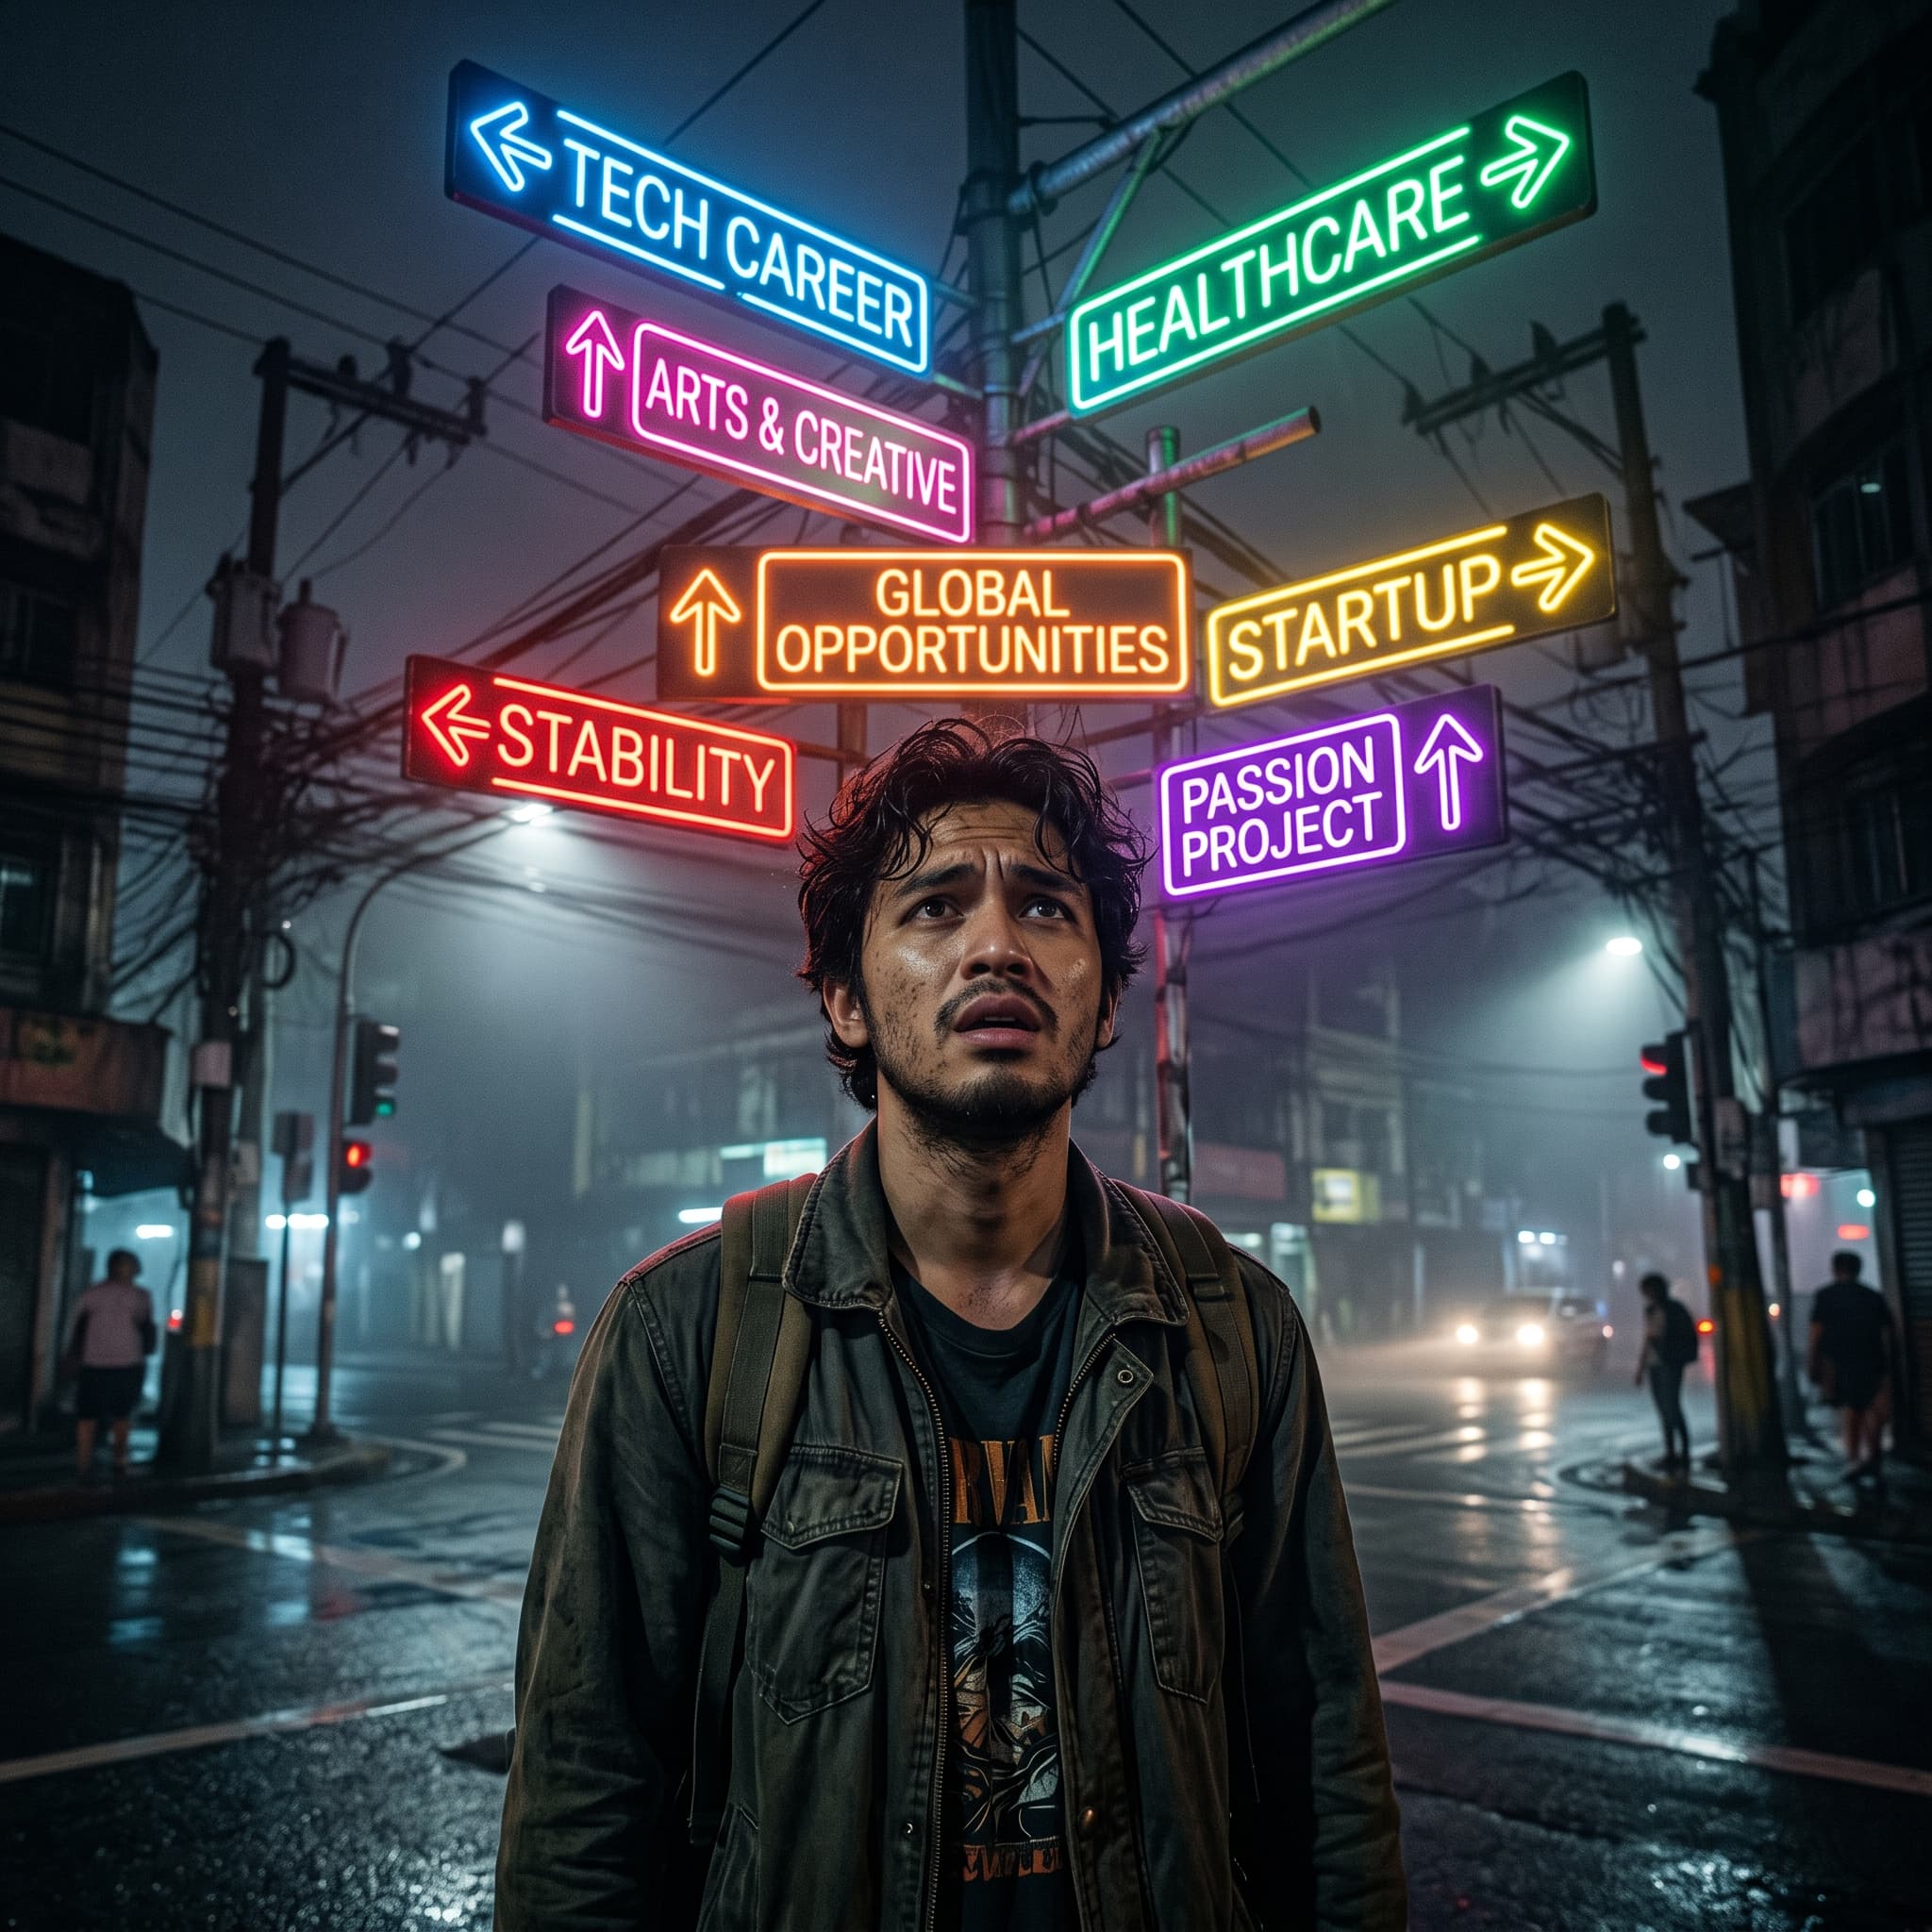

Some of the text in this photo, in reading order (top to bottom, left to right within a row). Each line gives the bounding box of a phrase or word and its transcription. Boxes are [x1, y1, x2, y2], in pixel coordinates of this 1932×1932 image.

[562, 136, 914, 349] TECH CAREER
[1087, 154, 1471, 384] HEALTHCARE
[643, 356, 958, 516] ARTS & CREATIVE
[875, 567, 1071, 618] GLOBAL
[1226, 552, 1503, 682] STARTUP
[775, 624, 1170, 675] OPPORTUNITIES
[497, 703, 775, 812] STABILITY
[1181, 734, 1376, 825] PASSION
[1181, 790, 1384, 878] PROJECT
